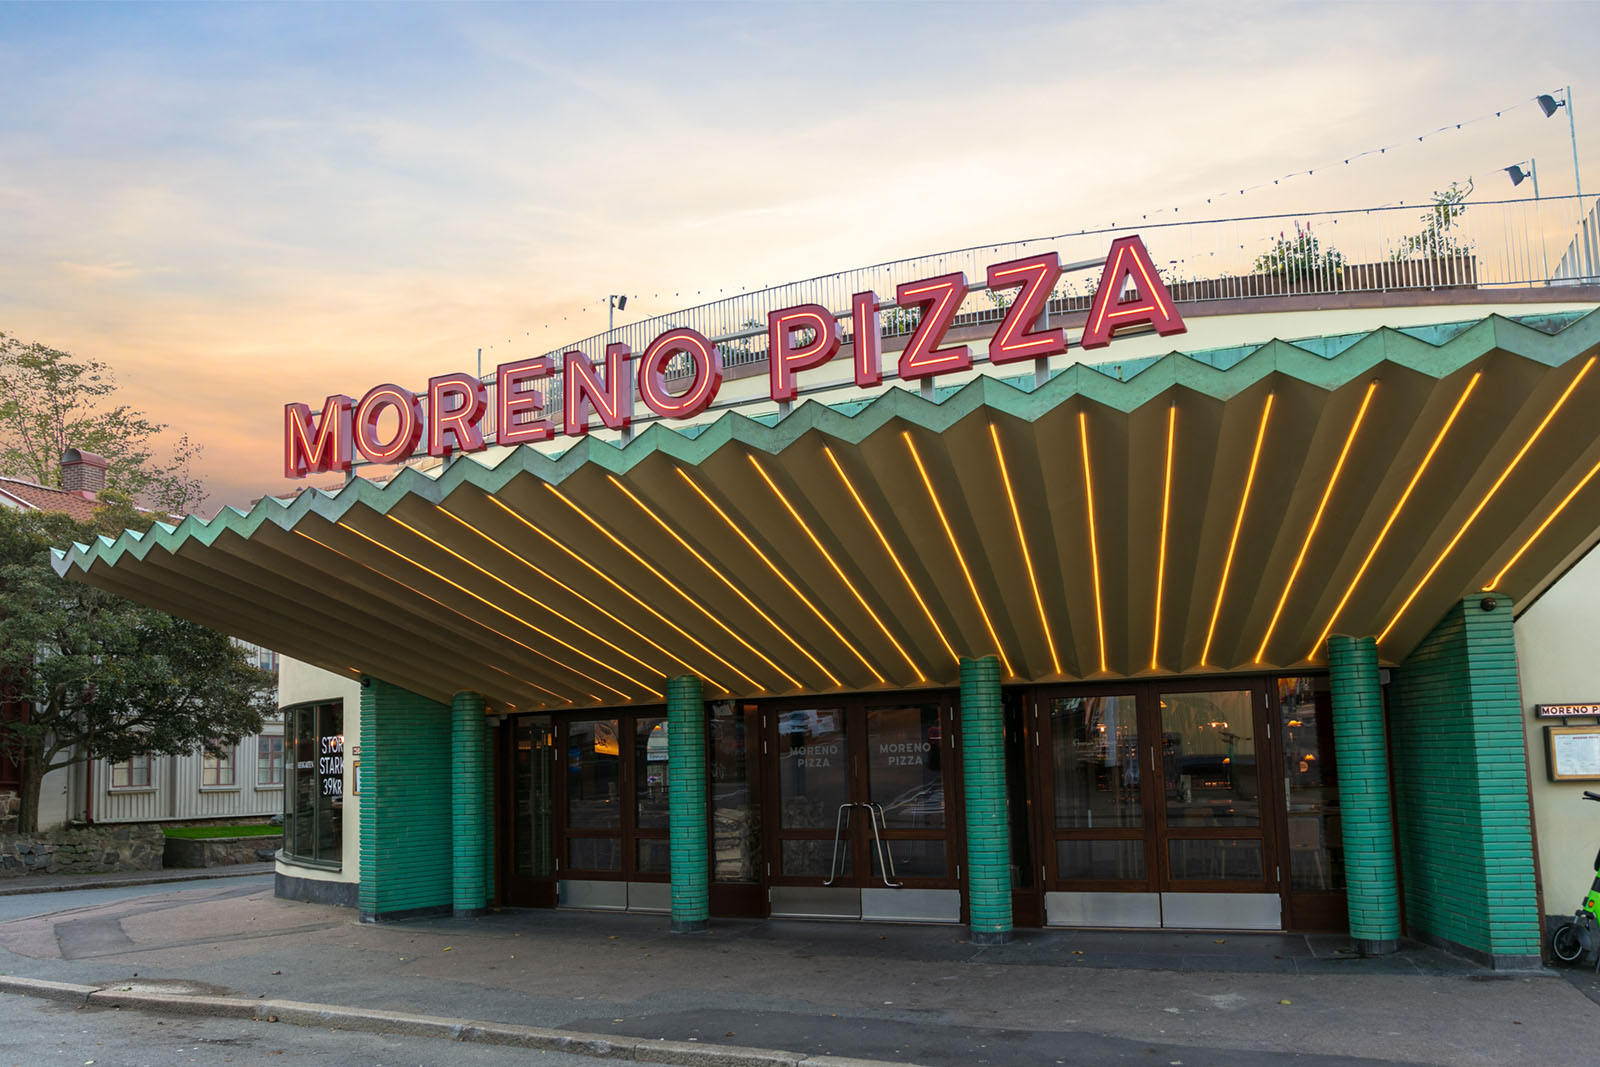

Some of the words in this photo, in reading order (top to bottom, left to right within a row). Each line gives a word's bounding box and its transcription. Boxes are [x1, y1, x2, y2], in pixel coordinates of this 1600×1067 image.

[285, 327, 722, 478] MORENO
[769, 234, 1187, 401] PIZZA
[1543, 706, 1587, 714] MORENO
[322, 736, 344, 753] STOR
[879, 743, 931, 753] MORENO
[790, 746, 837, 755] MORENO
[798, 758, 830, 767] PIZZA
[888, 756, 923, 766] PIZZA
[323, 778, 342, 795] 39KR
